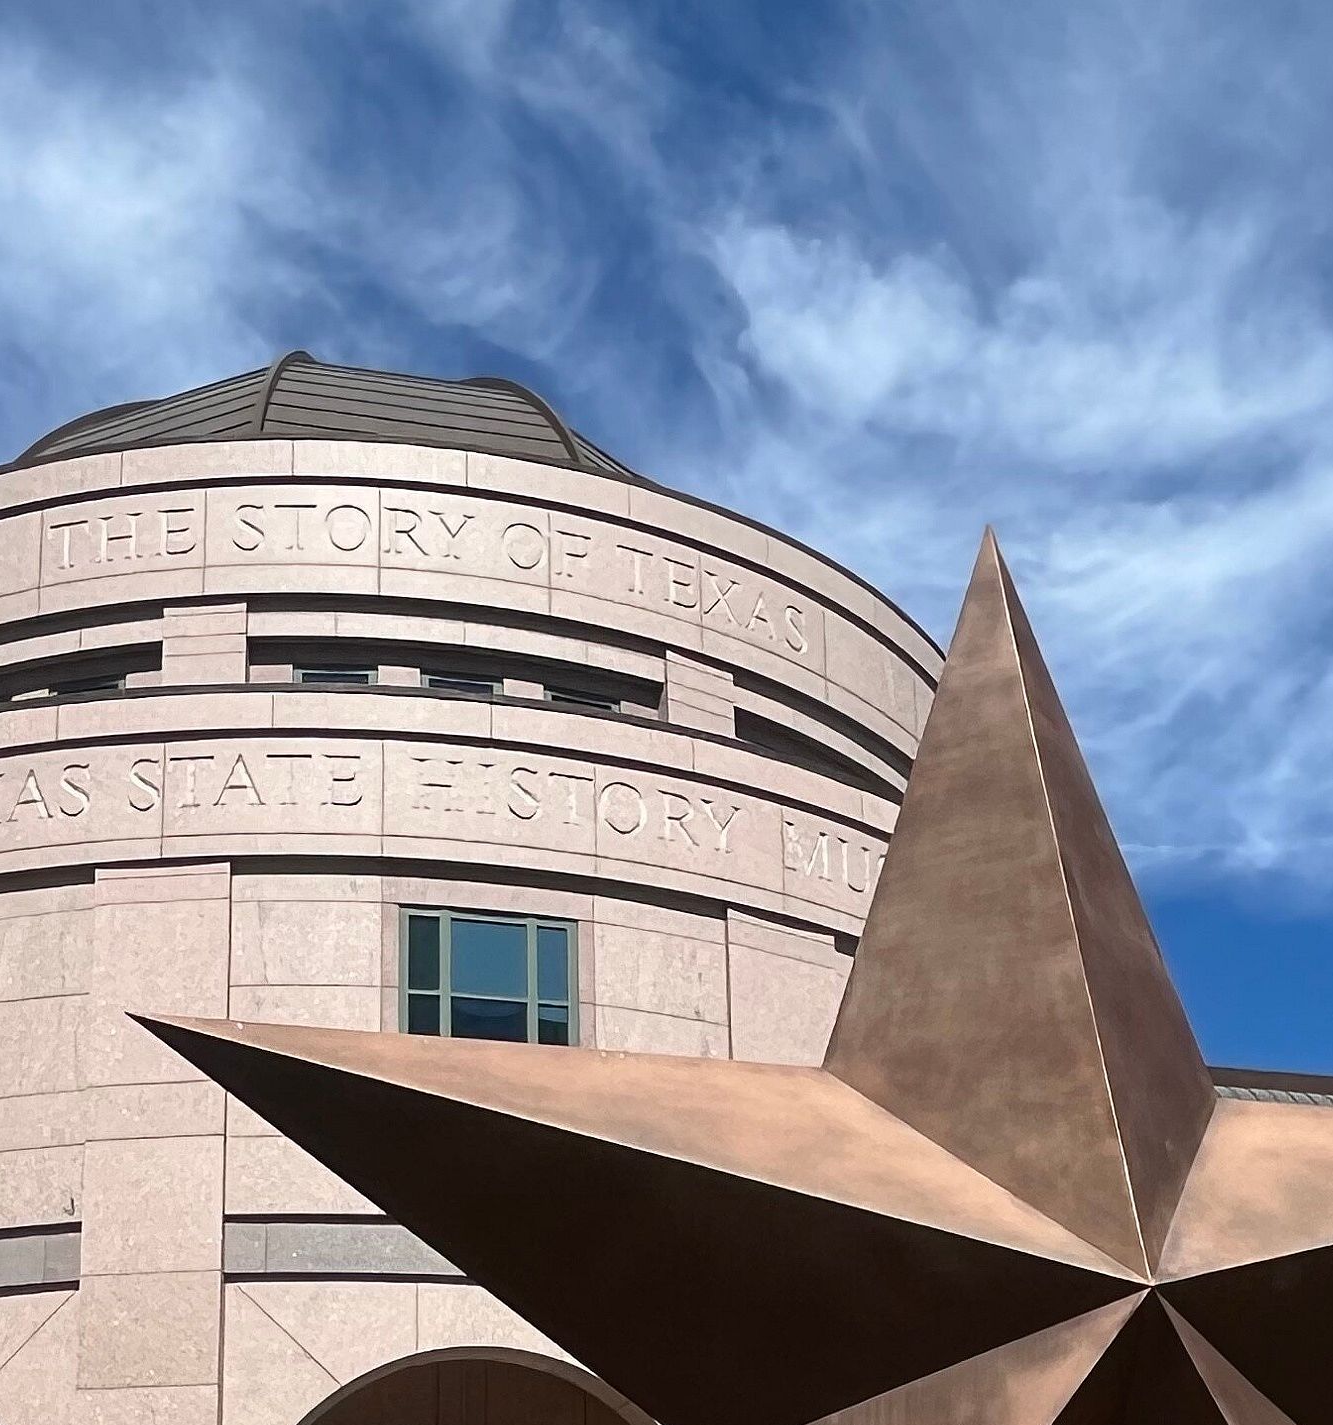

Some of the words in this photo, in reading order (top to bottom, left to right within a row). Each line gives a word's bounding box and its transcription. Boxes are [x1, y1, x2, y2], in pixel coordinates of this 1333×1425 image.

[48, 507, 197, 570] THE
[231, 503, 476, 560] STORY
[501, 522, 593, 578] OF
[615, 543, 809, 655] TEXAS
[127, 752, 364, 812] STATE
[410, 756, 742, 854] HISTORY
[782, 819, 887, 894] MU
